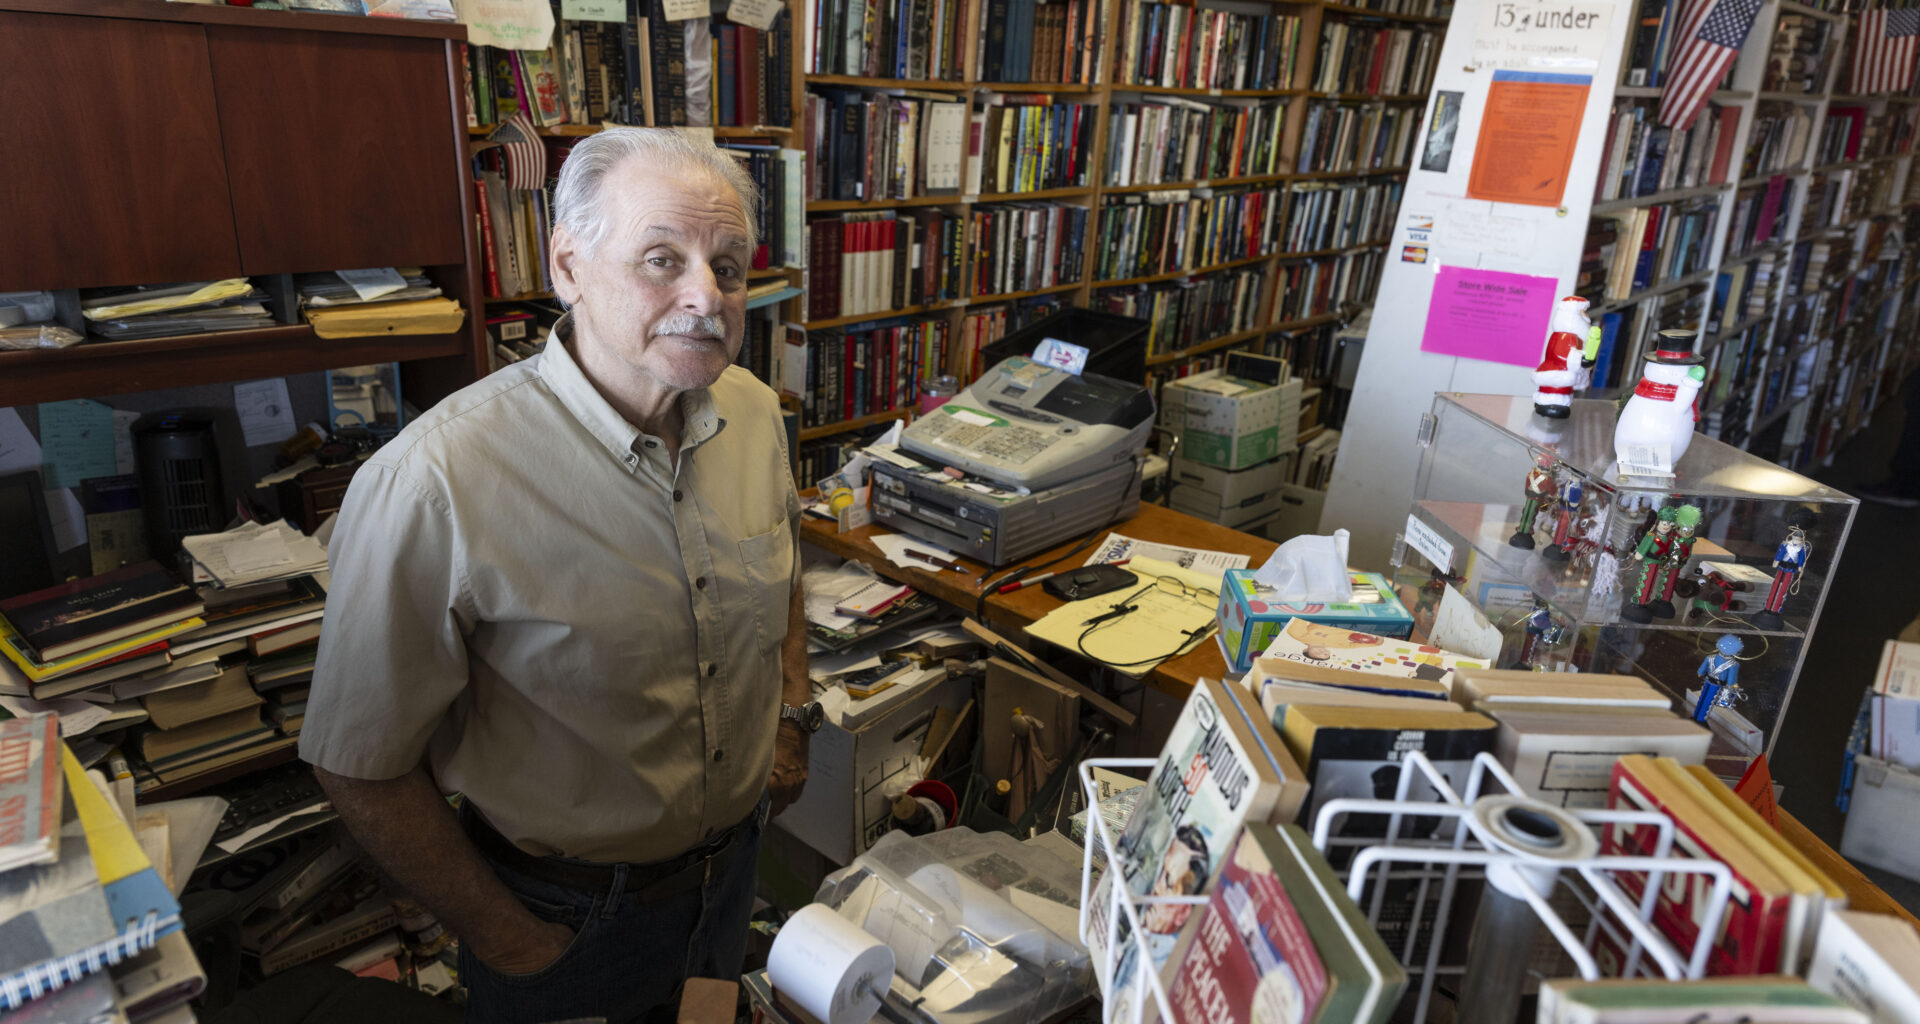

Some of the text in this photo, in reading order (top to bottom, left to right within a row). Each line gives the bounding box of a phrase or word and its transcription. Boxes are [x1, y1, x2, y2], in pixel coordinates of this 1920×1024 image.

[1494, 3, 1516, 27] 13
[1535, 6, 1599, 29] under
[1409, 232, 1428, 241] VISA
[1458, 280, 1528, 297] Store Wide Sale
[1184, 753, 1208, 796] 90
[1200, 724, 1249, 811] NAUTILUS
[1156, 754, 1192, 828] NORTH
[1201, 903, 1232, 966] THE
